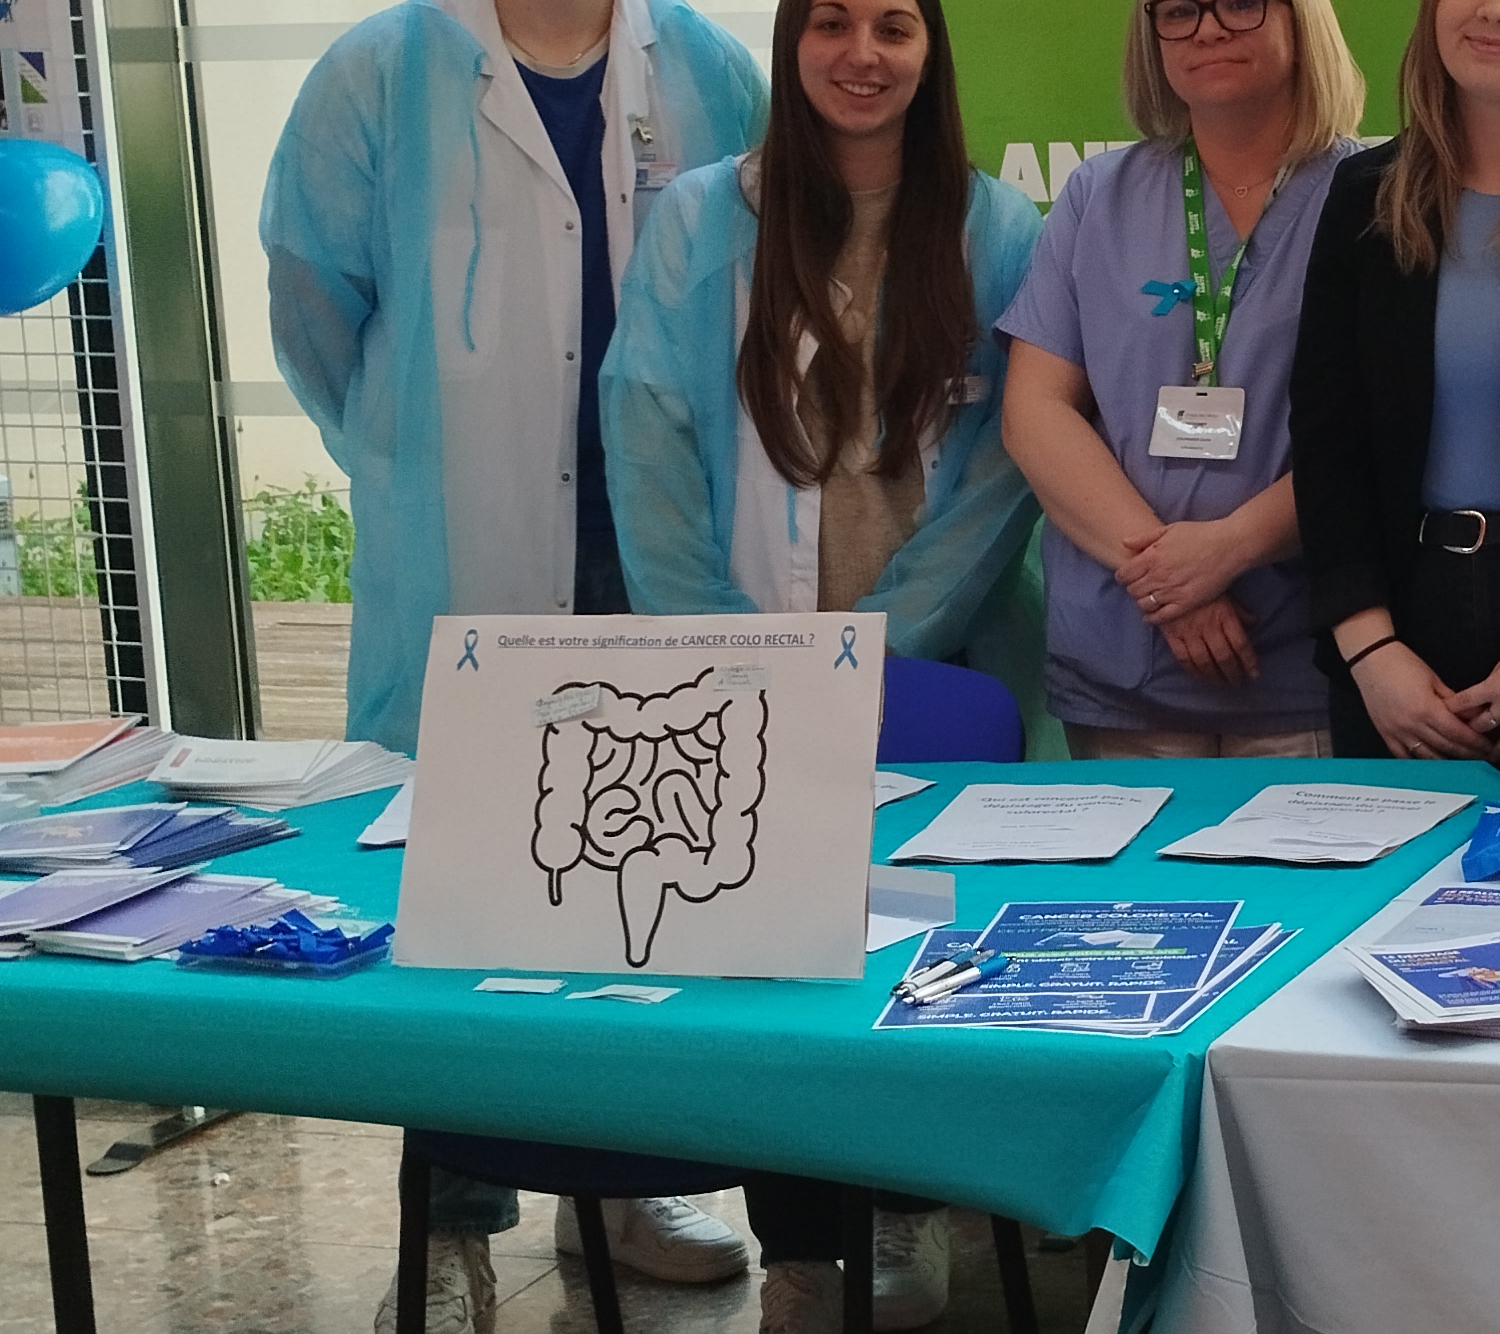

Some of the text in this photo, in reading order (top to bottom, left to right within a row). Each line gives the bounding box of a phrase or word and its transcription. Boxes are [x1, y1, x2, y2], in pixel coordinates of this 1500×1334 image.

[497, 632, 815, 648] Quelle est votre signification de CANCER COLO RECTAL ?
[1296, 790, 1362, 801] Comment
